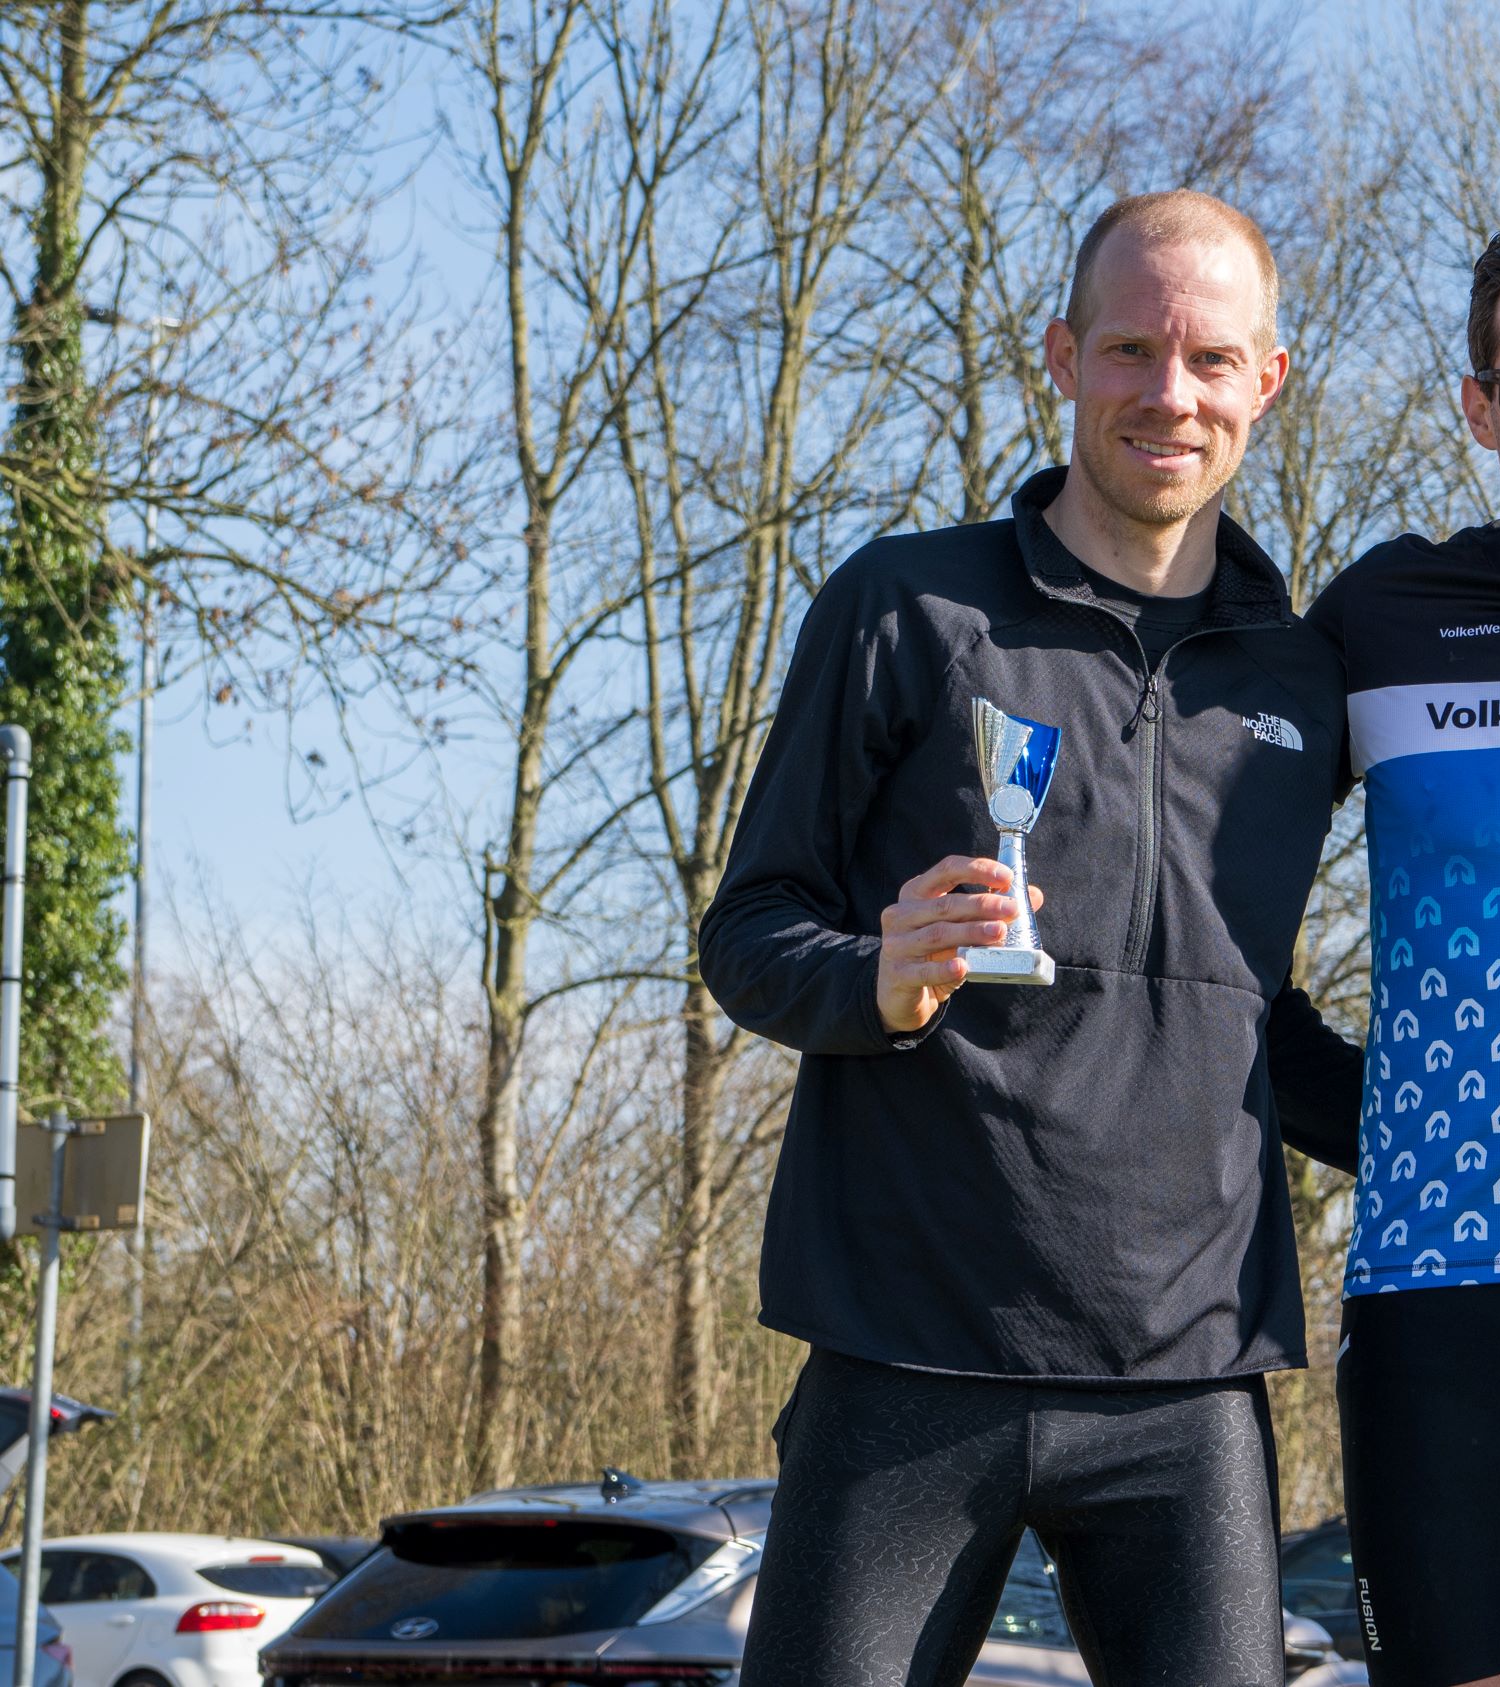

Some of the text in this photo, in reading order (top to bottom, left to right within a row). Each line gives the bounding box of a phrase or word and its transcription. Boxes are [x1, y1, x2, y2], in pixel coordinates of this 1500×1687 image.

[1242, 715, 1281, 736] NORTH
[1257, 711, 1280, 727] THE
[1253, 729, 1282, 746] FACE
[1359, 1578, 1382, 1651] FUSION
